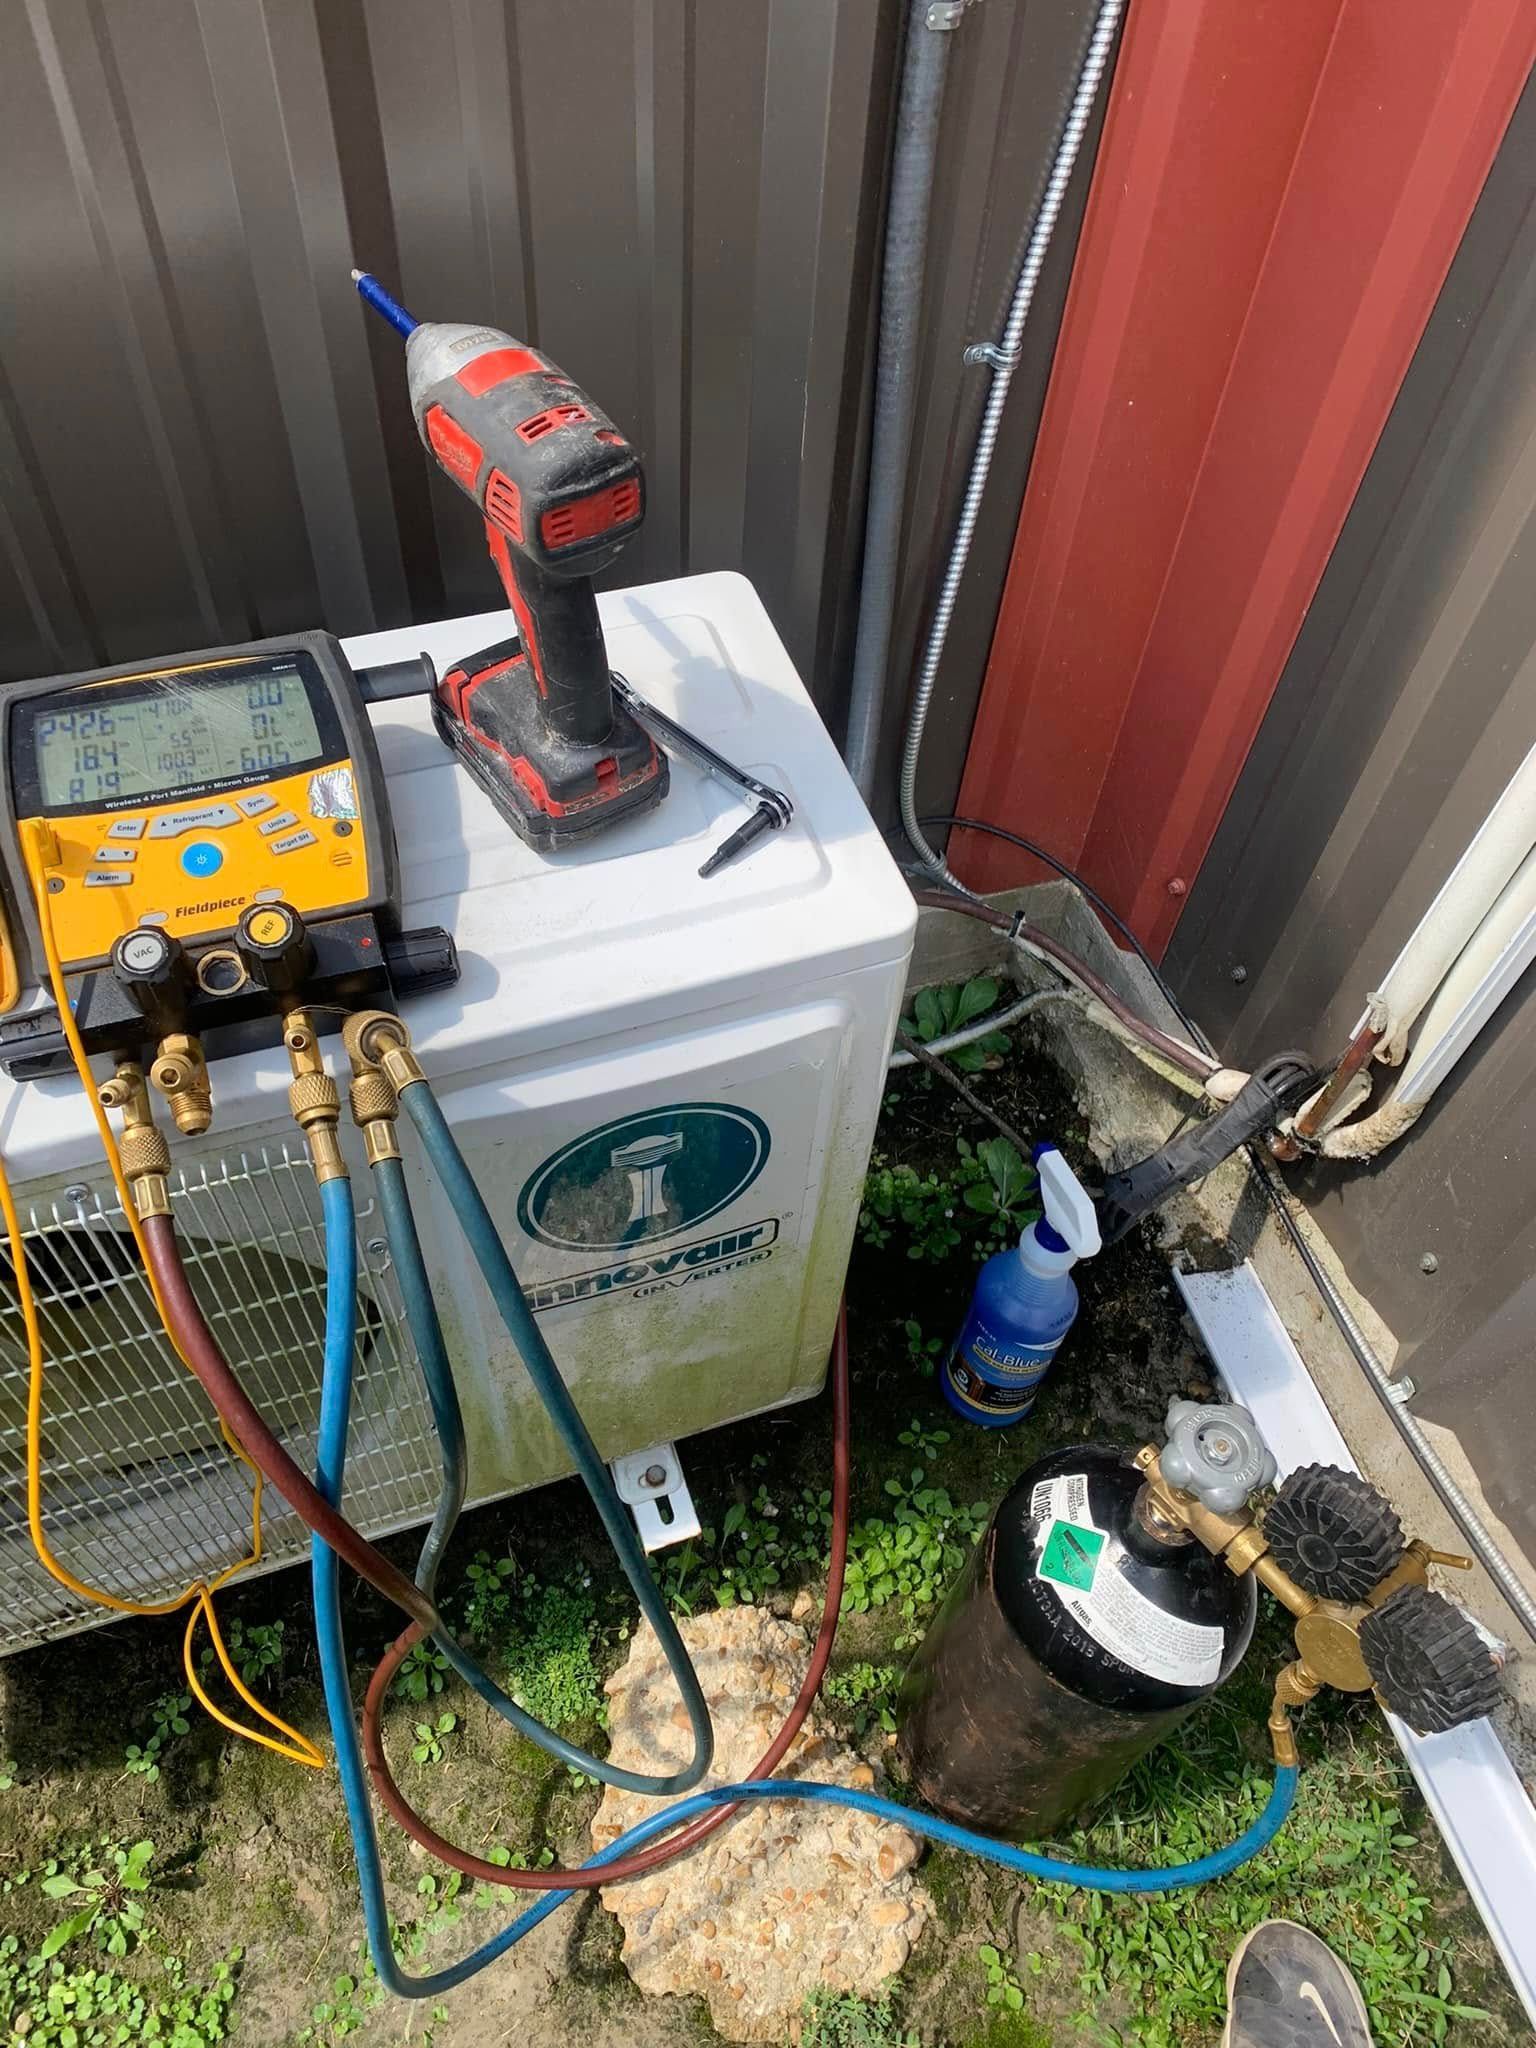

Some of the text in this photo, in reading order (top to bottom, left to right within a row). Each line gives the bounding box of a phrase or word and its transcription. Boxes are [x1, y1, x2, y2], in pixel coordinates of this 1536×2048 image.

[105, 796, 141, 809] Wireless
[170, 784, 205, 797] Manifold
[214, 778, 242, 789] Micron
[243, 773, 270, 785] Gauge
[172, 811, 214, 824] Refrigerant
[267, 817, 287, 829] Units
[117, 824, 137, 832] Enter
[275, 832, 310, 850] Target SH
[96, 874, 120, 882] Alarm
[175, 896, 246, 918] Fieldpiece
[261, 919, 276, 937] REF
[133, 945, 154, 960] VAC
[976, 1336, 1040, 1367] Cal-Blue
[1033, 1482, 1053, 1523] UN1066
[1071, 1600, 1093, 1626] Airgas
[1062, 1626, 1097, 1658] 2015
